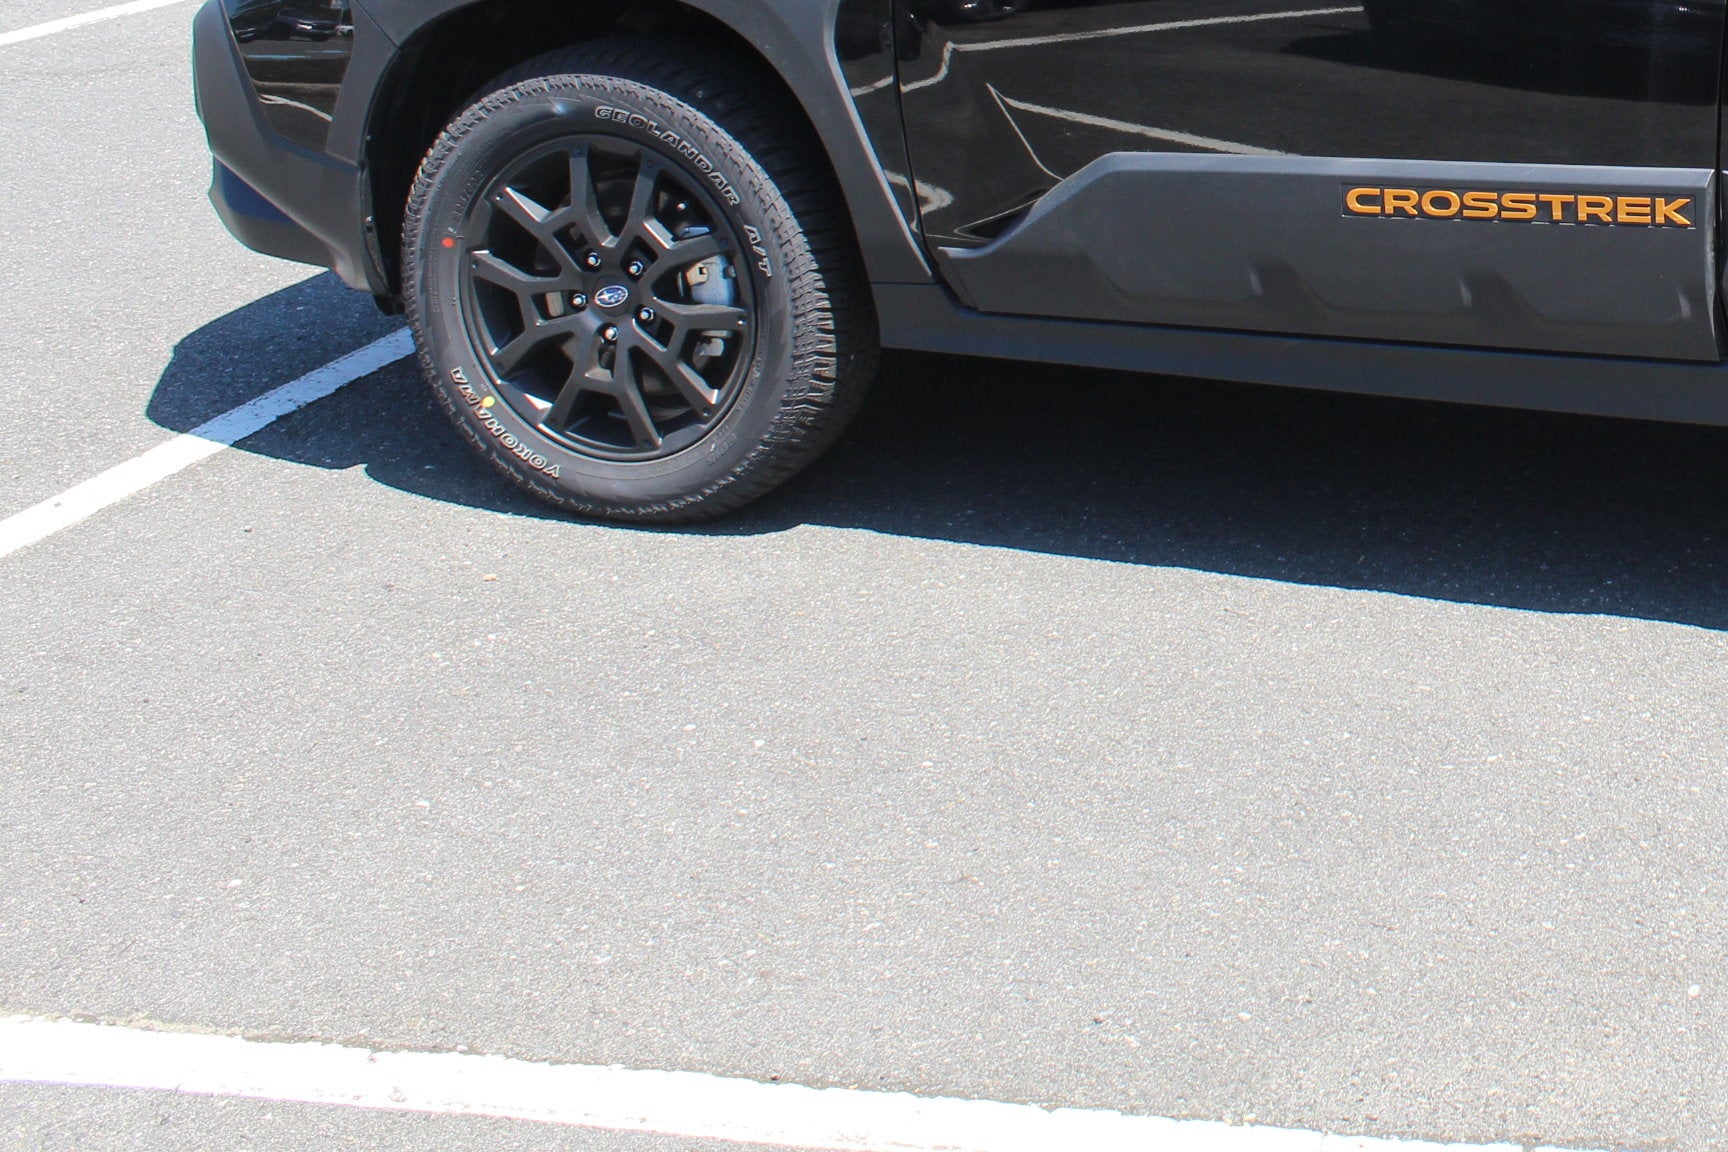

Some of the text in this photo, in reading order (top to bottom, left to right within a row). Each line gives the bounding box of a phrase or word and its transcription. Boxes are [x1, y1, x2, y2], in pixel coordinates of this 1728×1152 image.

[594, 104, 773, 278] GEOLANDAR A/T
[1345, 187, 1692, 225] CROSSTREK
[450, 366, 562, 479] YOKOHAMA
